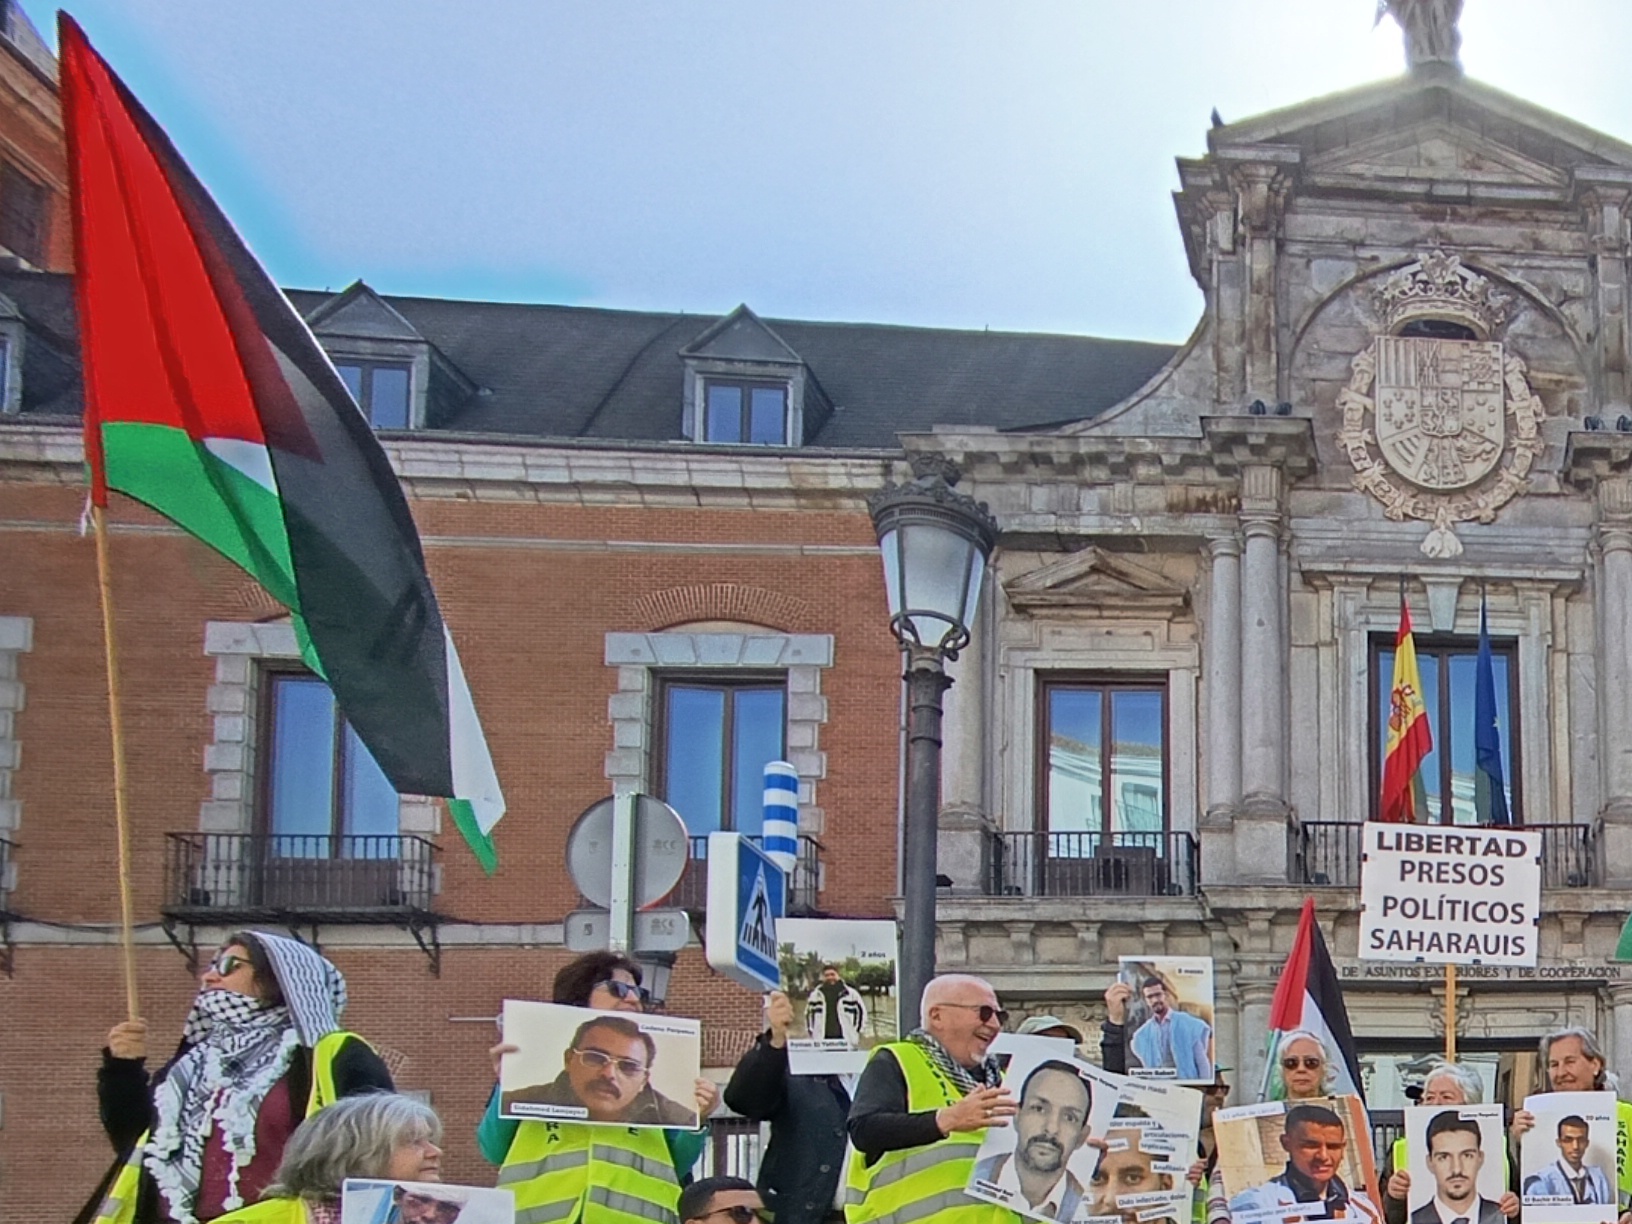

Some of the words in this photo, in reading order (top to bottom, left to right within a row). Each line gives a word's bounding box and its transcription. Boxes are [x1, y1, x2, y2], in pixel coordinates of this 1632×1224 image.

[1377, 831, 1527, 858] LIBERTAD
[1400, 860, 1505, 886] PRESOS
[1382, 894, 1525, 925] POLÍTICOS
[1370, 928, 1525, 956] SAHARAUIS
[1342, 966, 1358, 978] DE
[1365, 966, 1421, 978] ASUNTOS
[1425, 966, 1499, 978] EXTRIORES
[1505, 967, 1514, 978] Y
[1519, 967, 1533, 978] DE
[1616, 1121, 1627, 1177] SAHARA
